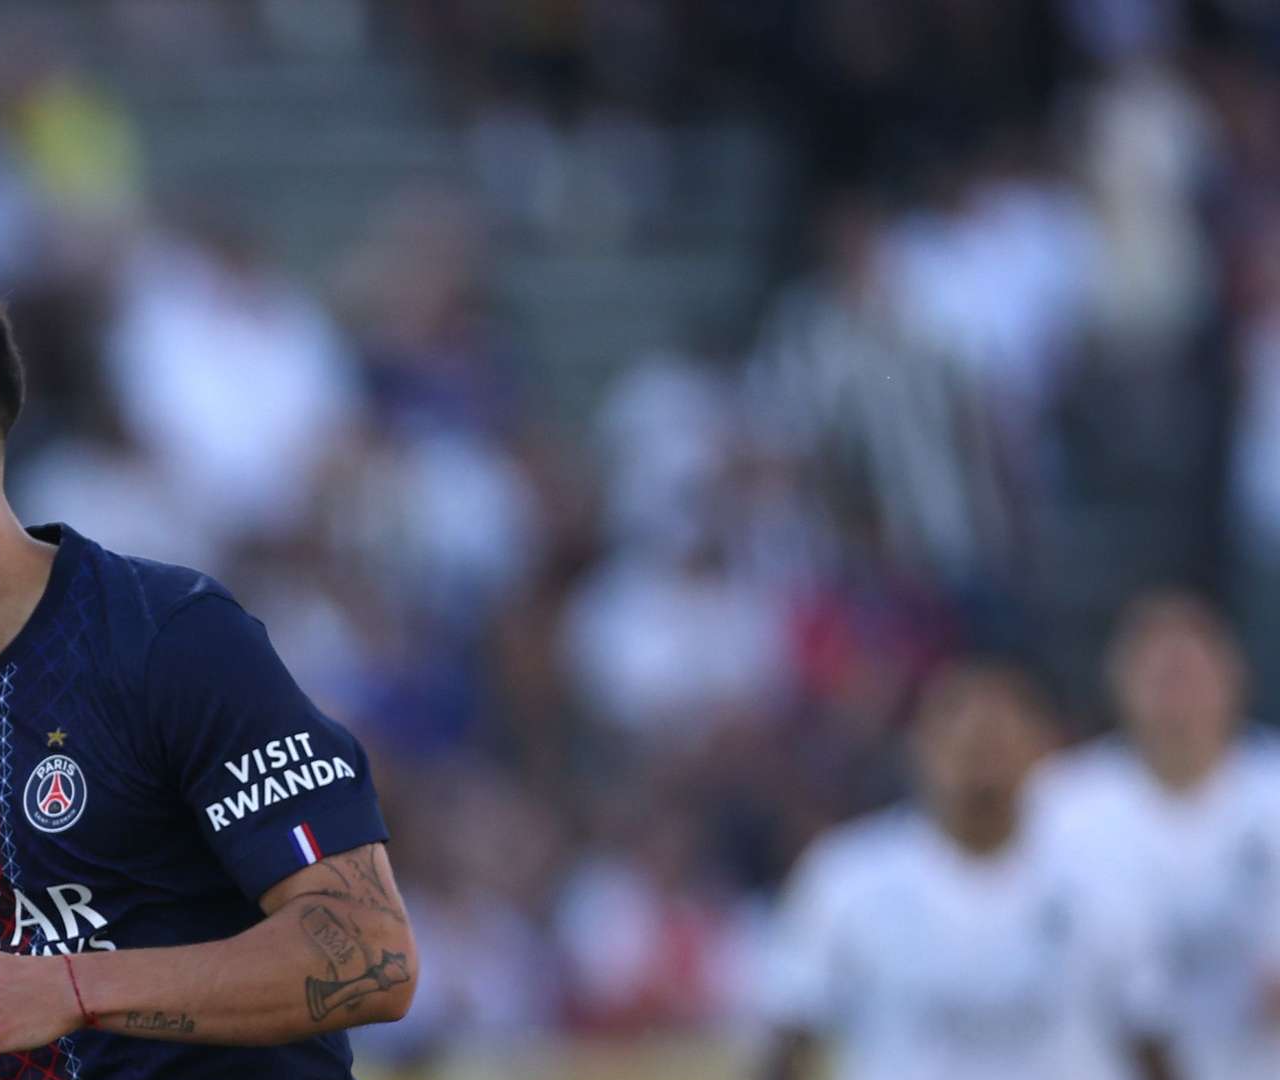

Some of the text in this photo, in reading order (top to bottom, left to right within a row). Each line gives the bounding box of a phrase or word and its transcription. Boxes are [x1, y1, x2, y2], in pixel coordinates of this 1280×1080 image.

[36, 758, 76, 779] PARIS
[224, 732, 314, 784] VISIT
[205, 757, 356, 832] RWANDA
